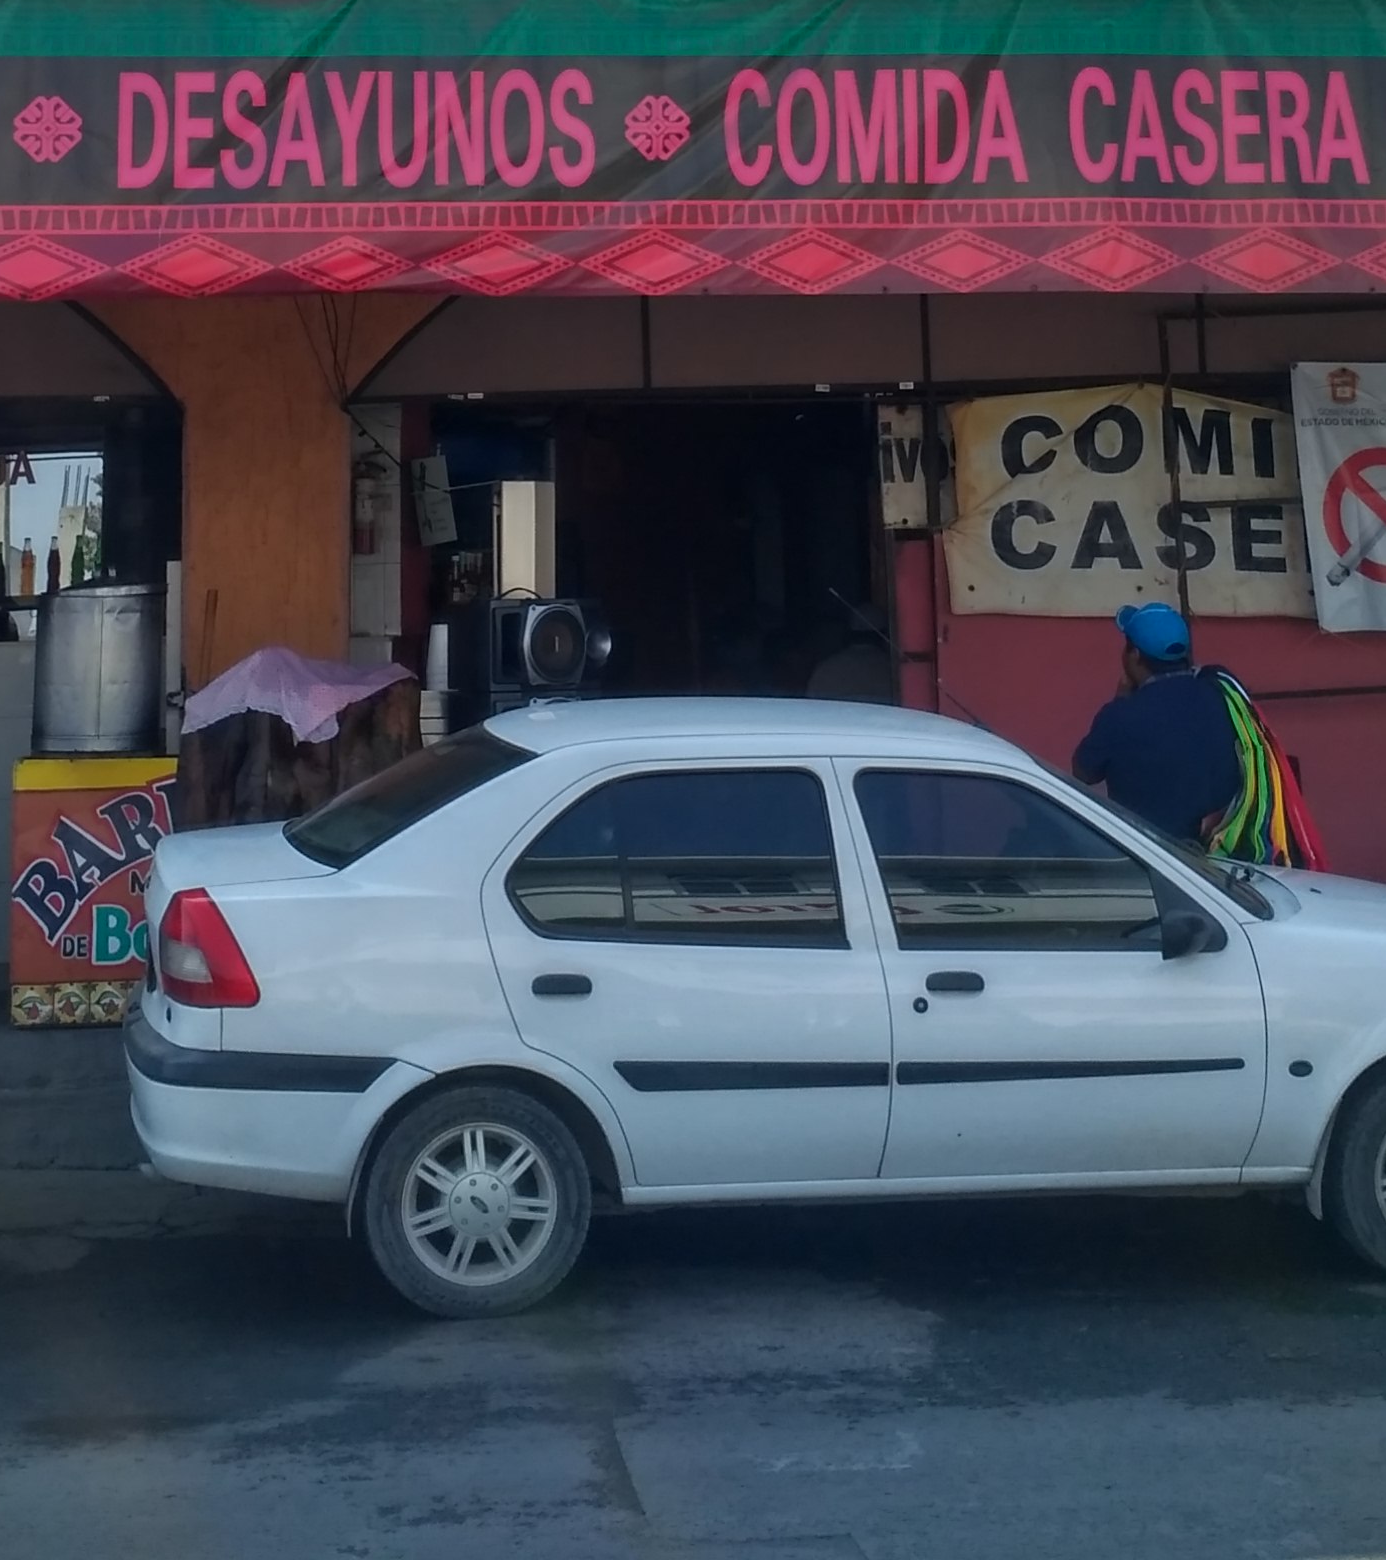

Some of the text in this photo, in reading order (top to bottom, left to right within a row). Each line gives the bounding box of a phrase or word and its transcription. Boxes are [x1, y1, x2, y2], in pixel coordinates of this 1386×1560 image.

[116, 69, 597, 189] DESAYUNOS
[724, 68, 1030, 186] COMIDA
[1069, 67, 1370, 186] CASERA
[1000, 404, 1300, 479] COMI
[1301, 418, 1339, 427] ESTADO
[1341, 418, 1354, 426] DE
[991, 499, 1311, 574] CASE
[62, 935, 88, 958] DE
